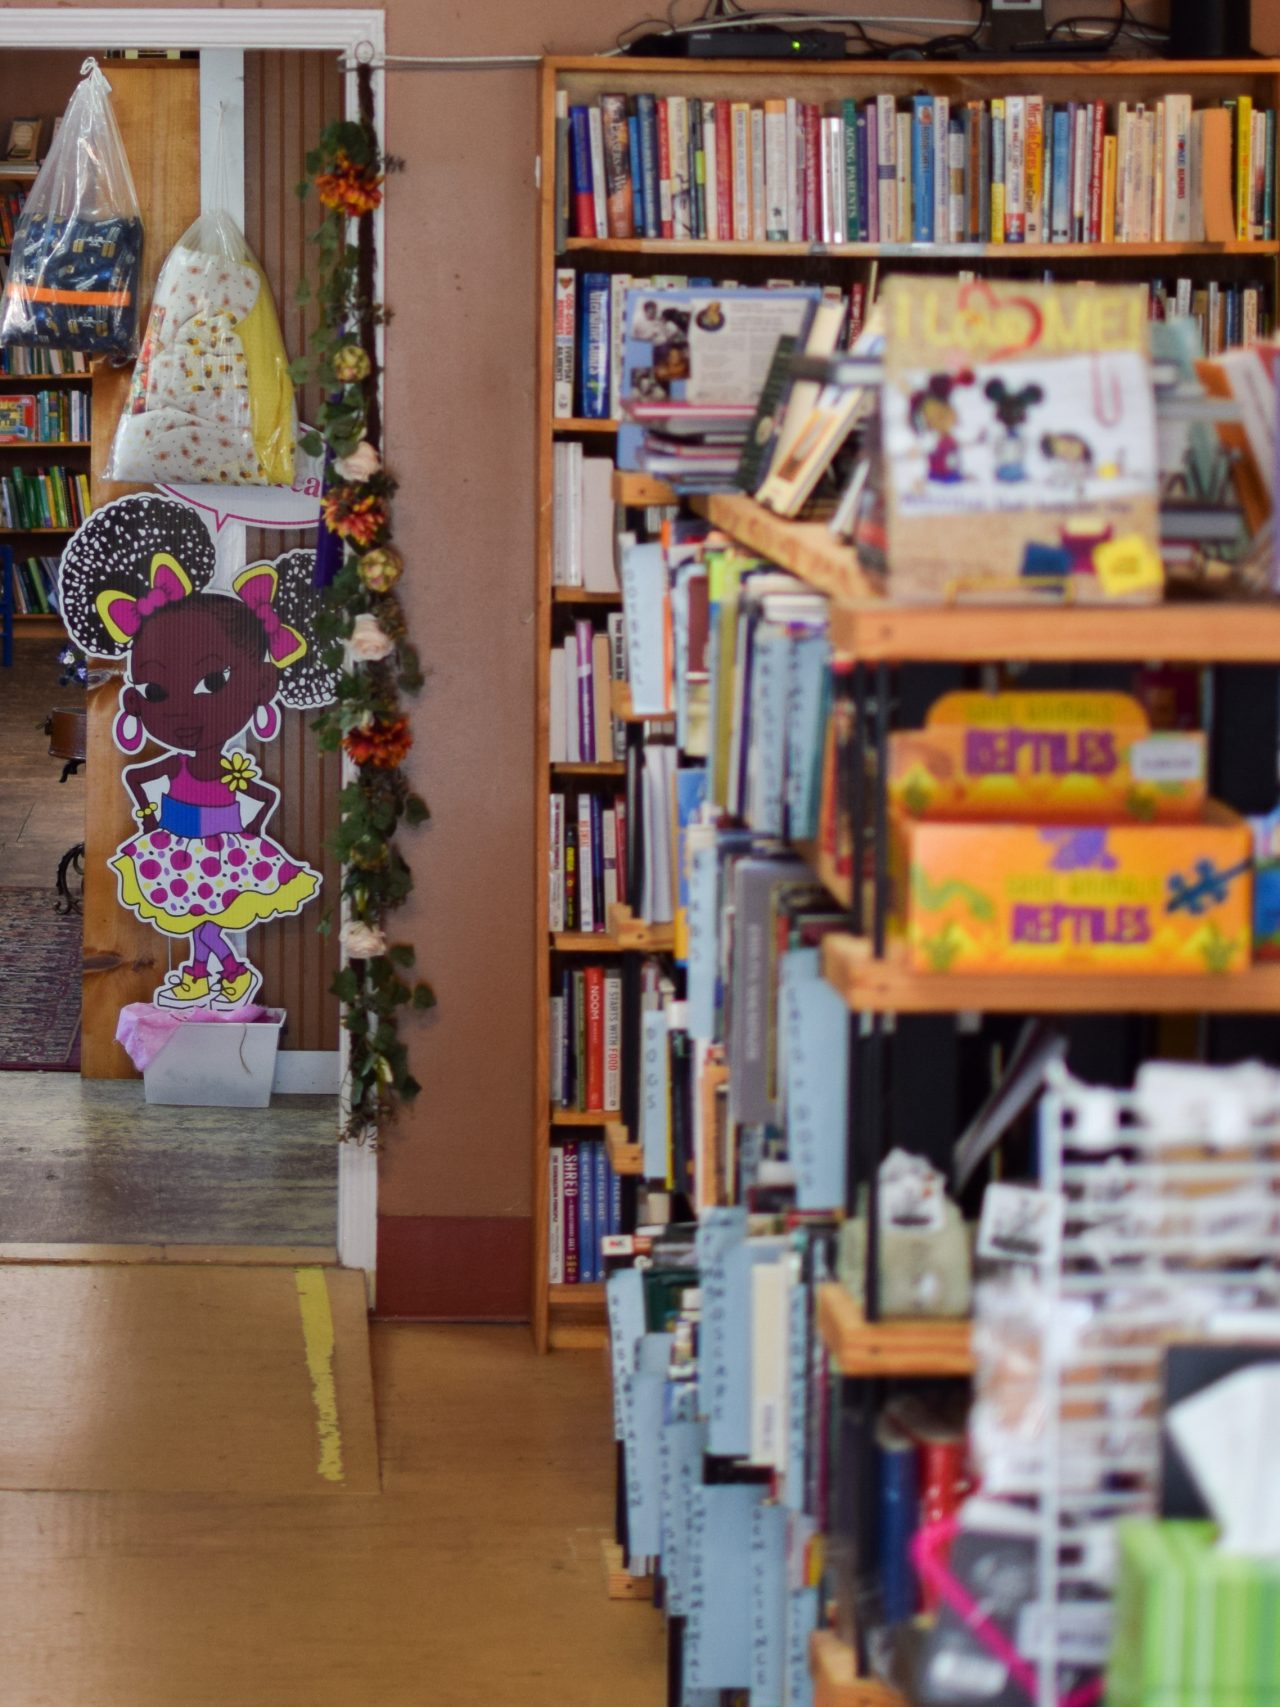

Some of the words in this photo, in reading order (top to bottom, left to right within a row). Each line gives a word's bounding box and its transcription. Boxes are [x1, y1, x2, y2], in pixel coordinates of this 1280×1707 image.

[846, 126, 856, 163] AGING
[847, 166, 857, 219] PARENTS
[964, 728, 1118, 777] REPTILES
[1011, 904, 1151, 944] REPTILES
[590, 985, 600, 1020] NOOM
[608, 981, 618, 989] IT
[608, 991, 619, 1021] STARTS
[608, 1023, 618, 1046] WITH
[608, 1048, 618, 1071] FOOD
[646, 1027, 659, 1110] DOGS
[564, 1154, 577, 1197] SHRED
[597, 1163, 605, 1178] MET
